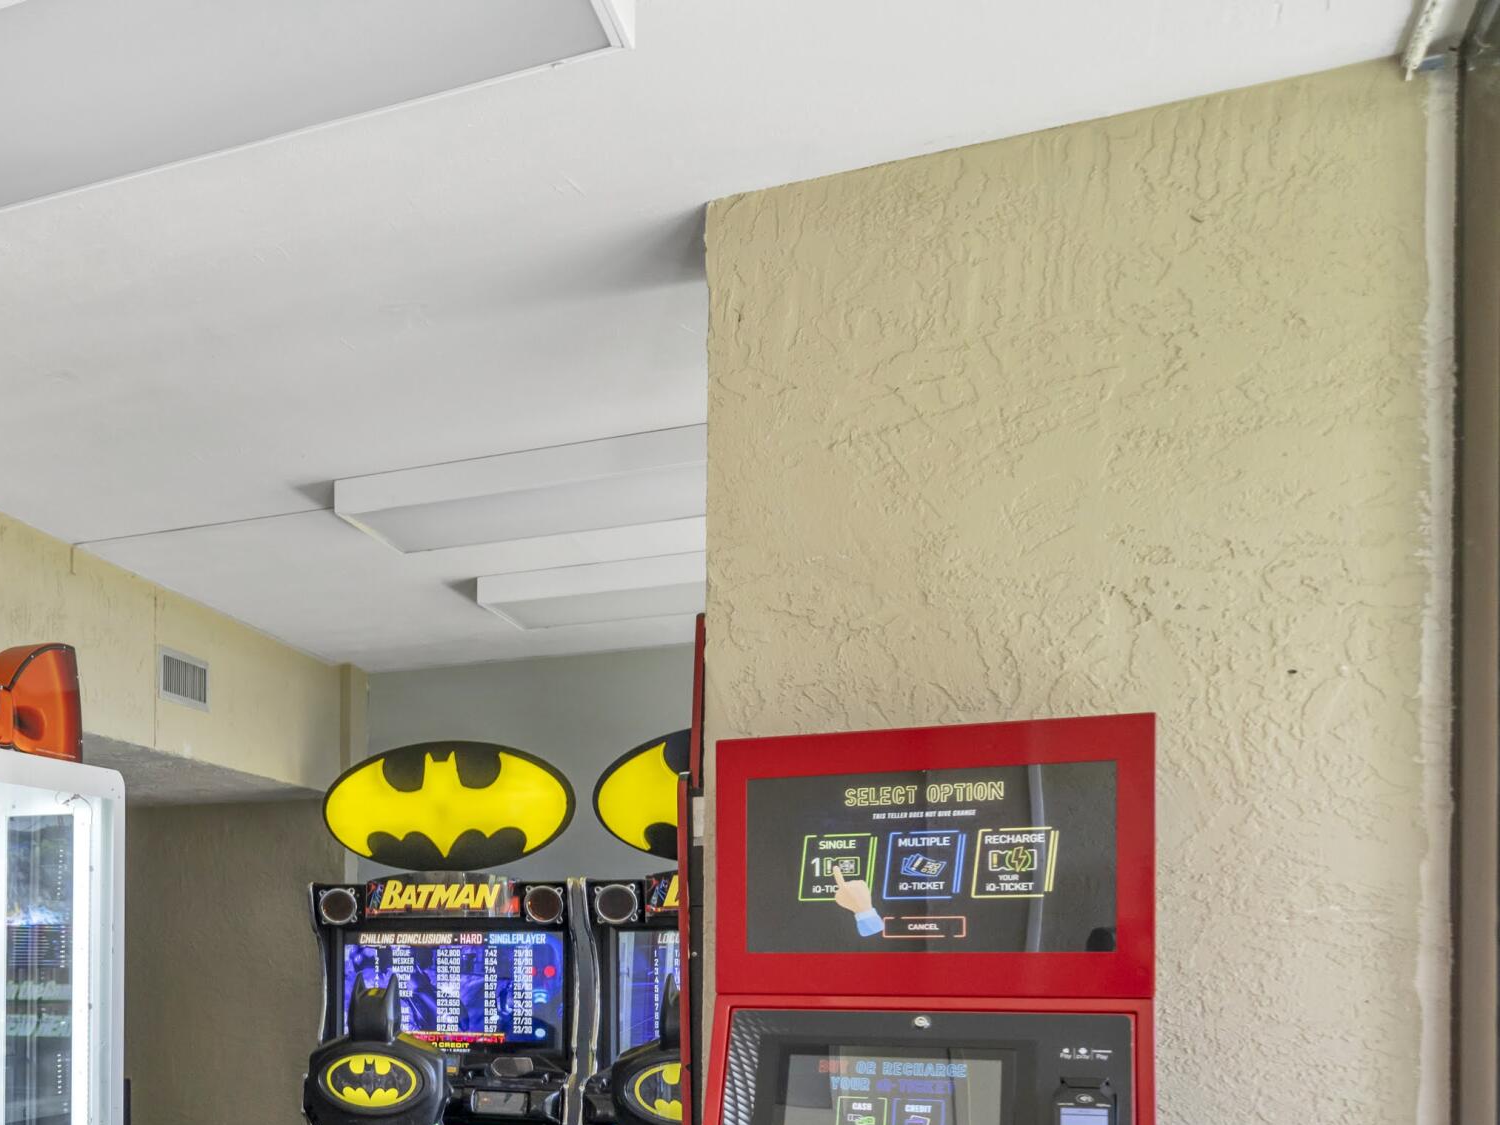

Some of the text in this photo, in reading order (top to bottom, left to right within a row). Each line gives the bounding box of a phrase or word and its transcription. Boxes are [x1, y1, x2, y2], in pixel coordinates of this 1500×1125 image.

[844, 781, 1004, 806] SELECT OPTION
[898, 836, 950, 847] MULTIPLE
[984, 833, 1045, 844] RECHARGE
[818, 840, 856, 850] SINGLE
[812, 884, 839, 893] iQ-TIC
[379, 879, 501, 910] BATMAN
[907, 923, 939, 931] CANCEL
[360, 933, 396, 944] CHILLING
[396, 933, 453, 944] CONCLUSIONS
[460, 933, 483, 944] HARD
[489, 933, 547, 944] SINGLEPLAYER
[818, 1059, 969, 1078] BUY OR RECHARGE
[830, 1076, 871, 1091] YOUR
[851, 1102, 873, 1111] CASH
[904, 1104, 933, 1113] CREDIT
